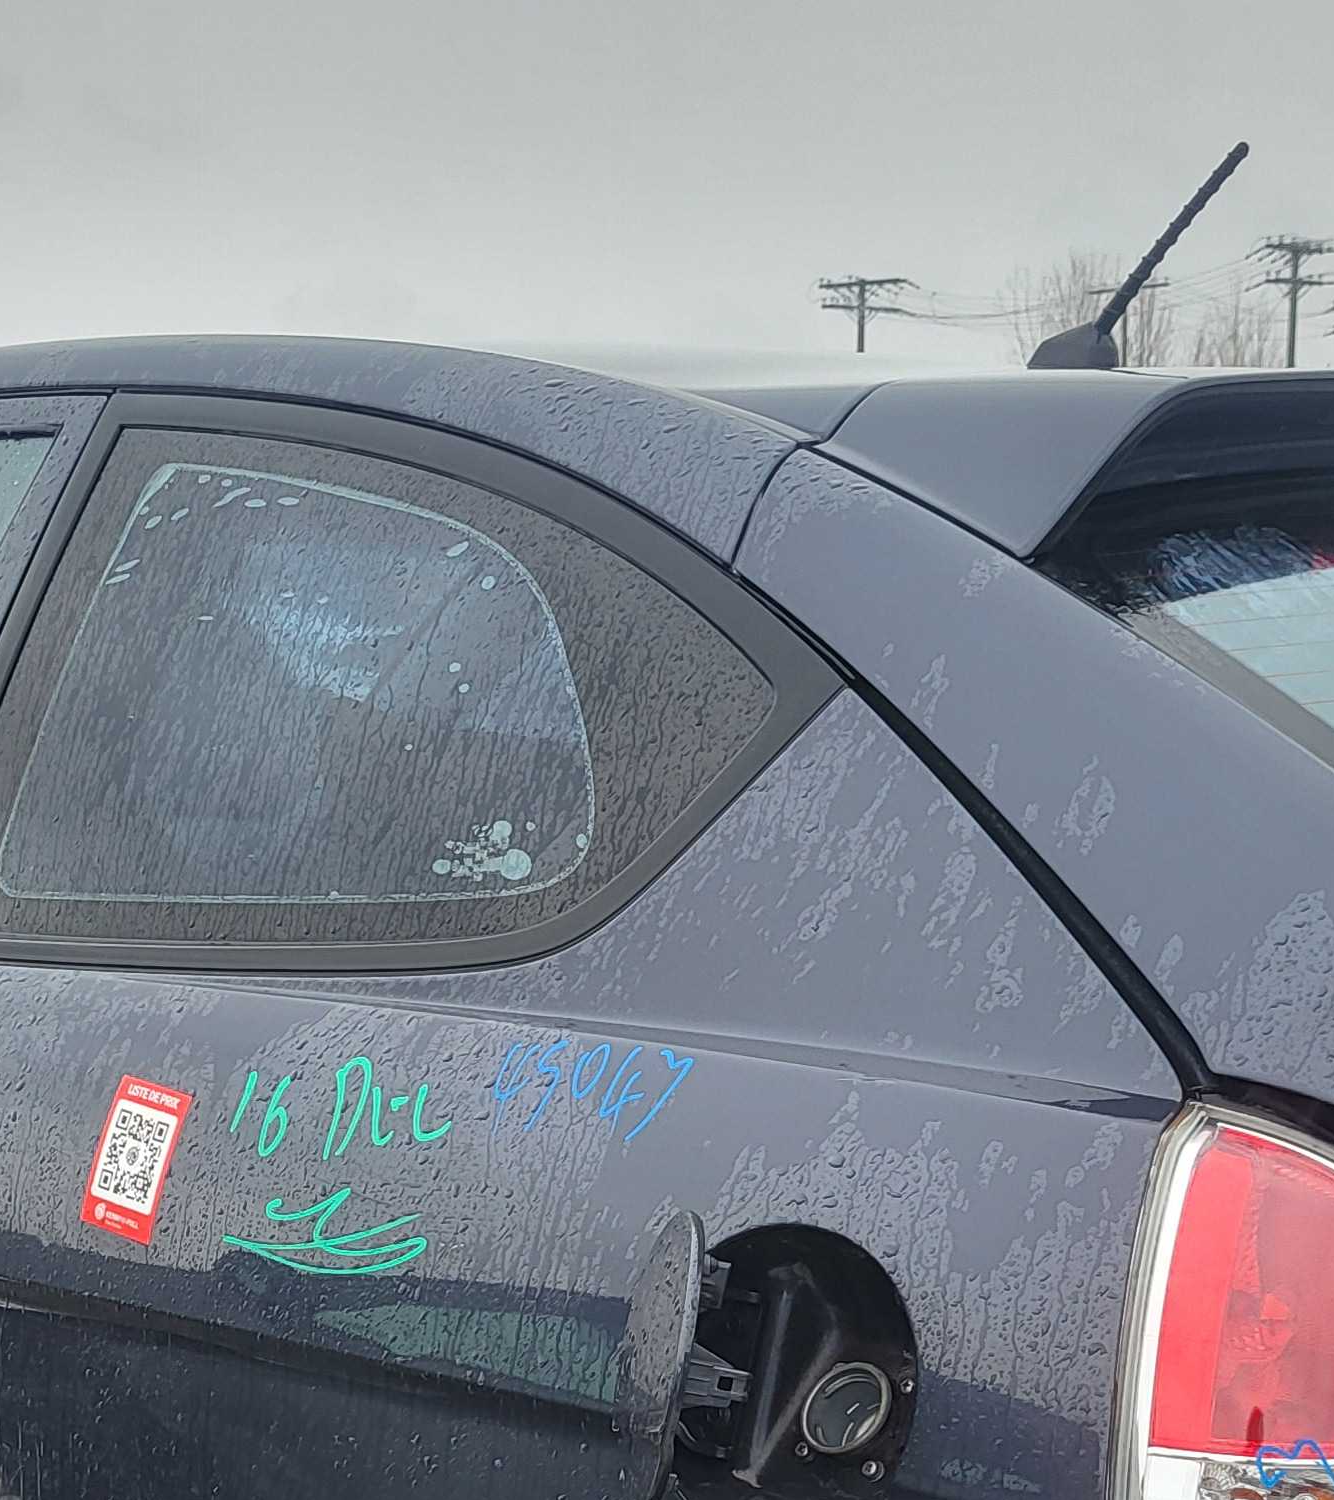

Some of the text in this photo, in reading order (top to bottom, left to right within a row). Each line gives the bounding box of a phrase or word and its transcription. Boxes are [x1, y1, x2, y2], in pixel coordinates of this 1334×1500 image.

[128, 1083, 181, 1110] LISTE DE PRIX
[230, 1071, 292, 1158] 16
